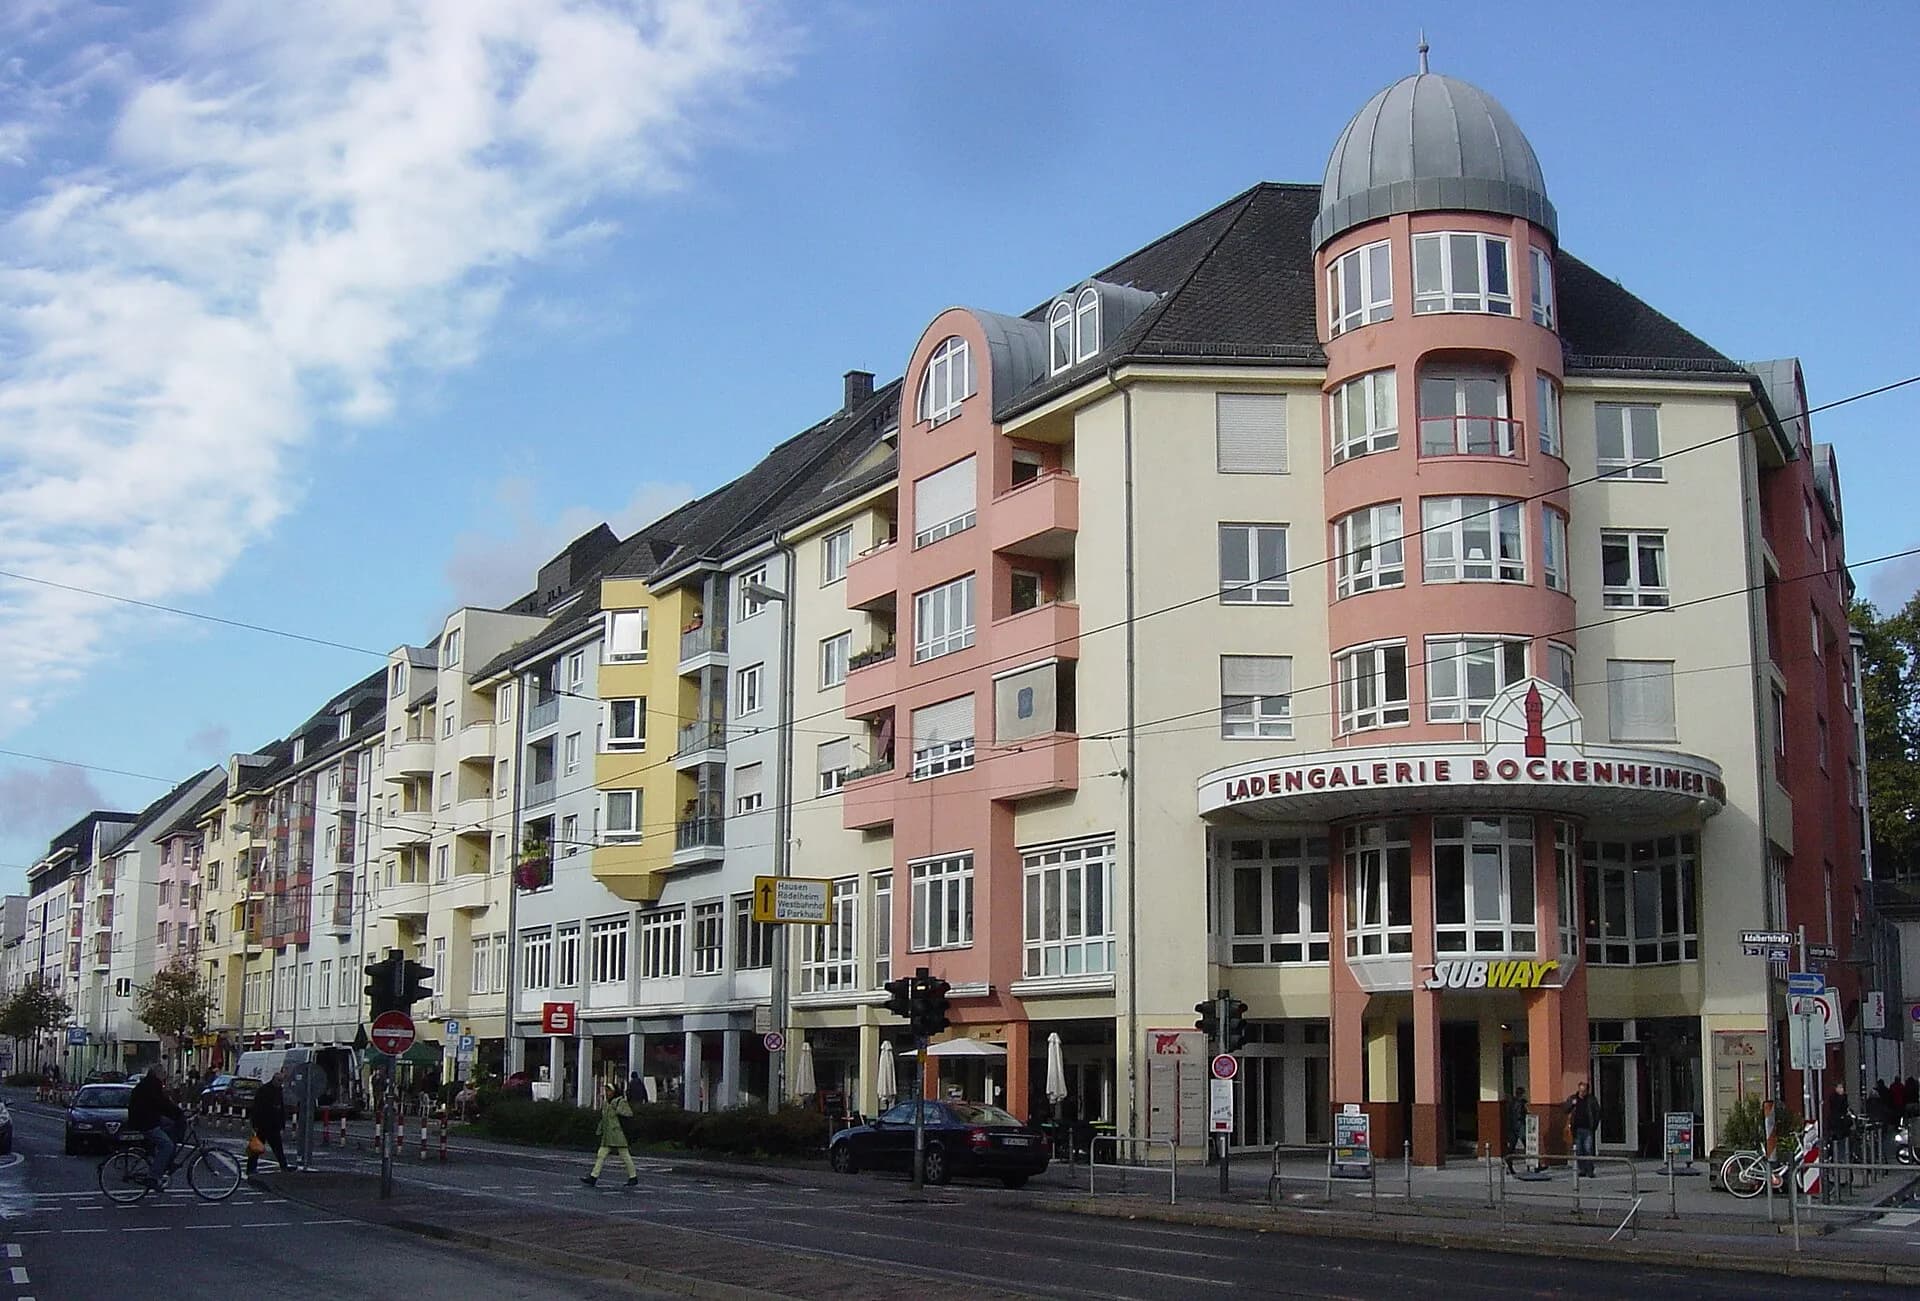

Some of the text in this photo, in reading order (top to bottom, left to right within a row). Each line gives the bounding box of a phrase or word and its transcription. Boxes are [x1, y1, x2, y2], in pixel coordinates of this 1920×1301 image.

[1226, 759, 1450, 801] LADENGALERIE
[1471, 758, 1704, 793] BOCKENHEIMER
[778, 882, 808, 891] Hausen
[778, 900, 826, 910] Westbahnhof
[787, 909, 823, 918] Parkhaus
[1744, 933, 1789, 944] Adalbertstraße
[1425, 959, 1561, 990] SUBWAY
[462, 1037, 472, 1050] P
